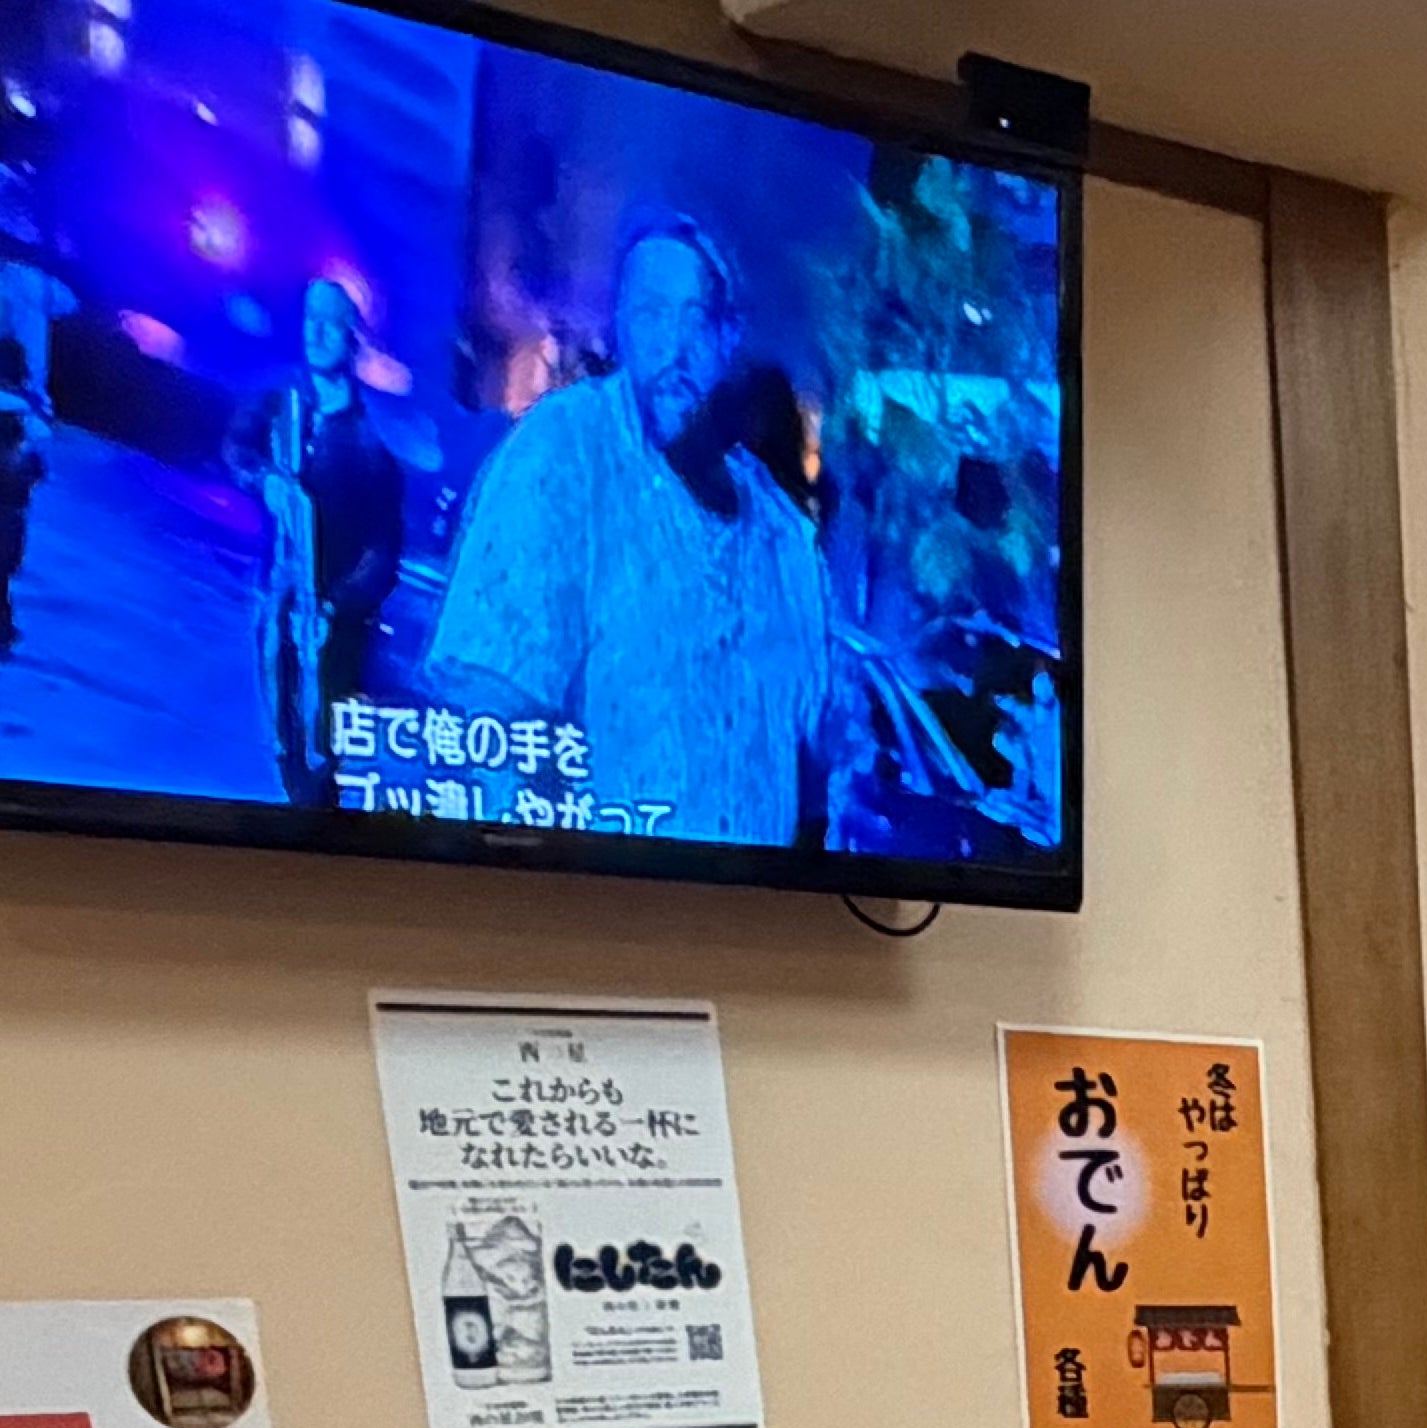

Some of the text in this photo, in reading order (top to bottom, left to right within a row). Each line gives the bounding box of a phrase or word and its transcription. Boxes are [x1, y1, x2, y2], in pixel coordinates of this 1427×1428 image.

[331, 698, 589, 779] 店で俺の手を
[491, 1077, 624, 1106] これからも
[1206, 1062, 1237, 1132] 冬は
[419, 1107, 700, 1139] 地元で愛される一杯に
[460, 1141, 668, 1170] なれたらいいな。
[1054, 1066, 1129, 1292] おでん
[1177, 1097, 1210, 1239] やっぱり
[553, 1238, 722, 1292] にしたん
